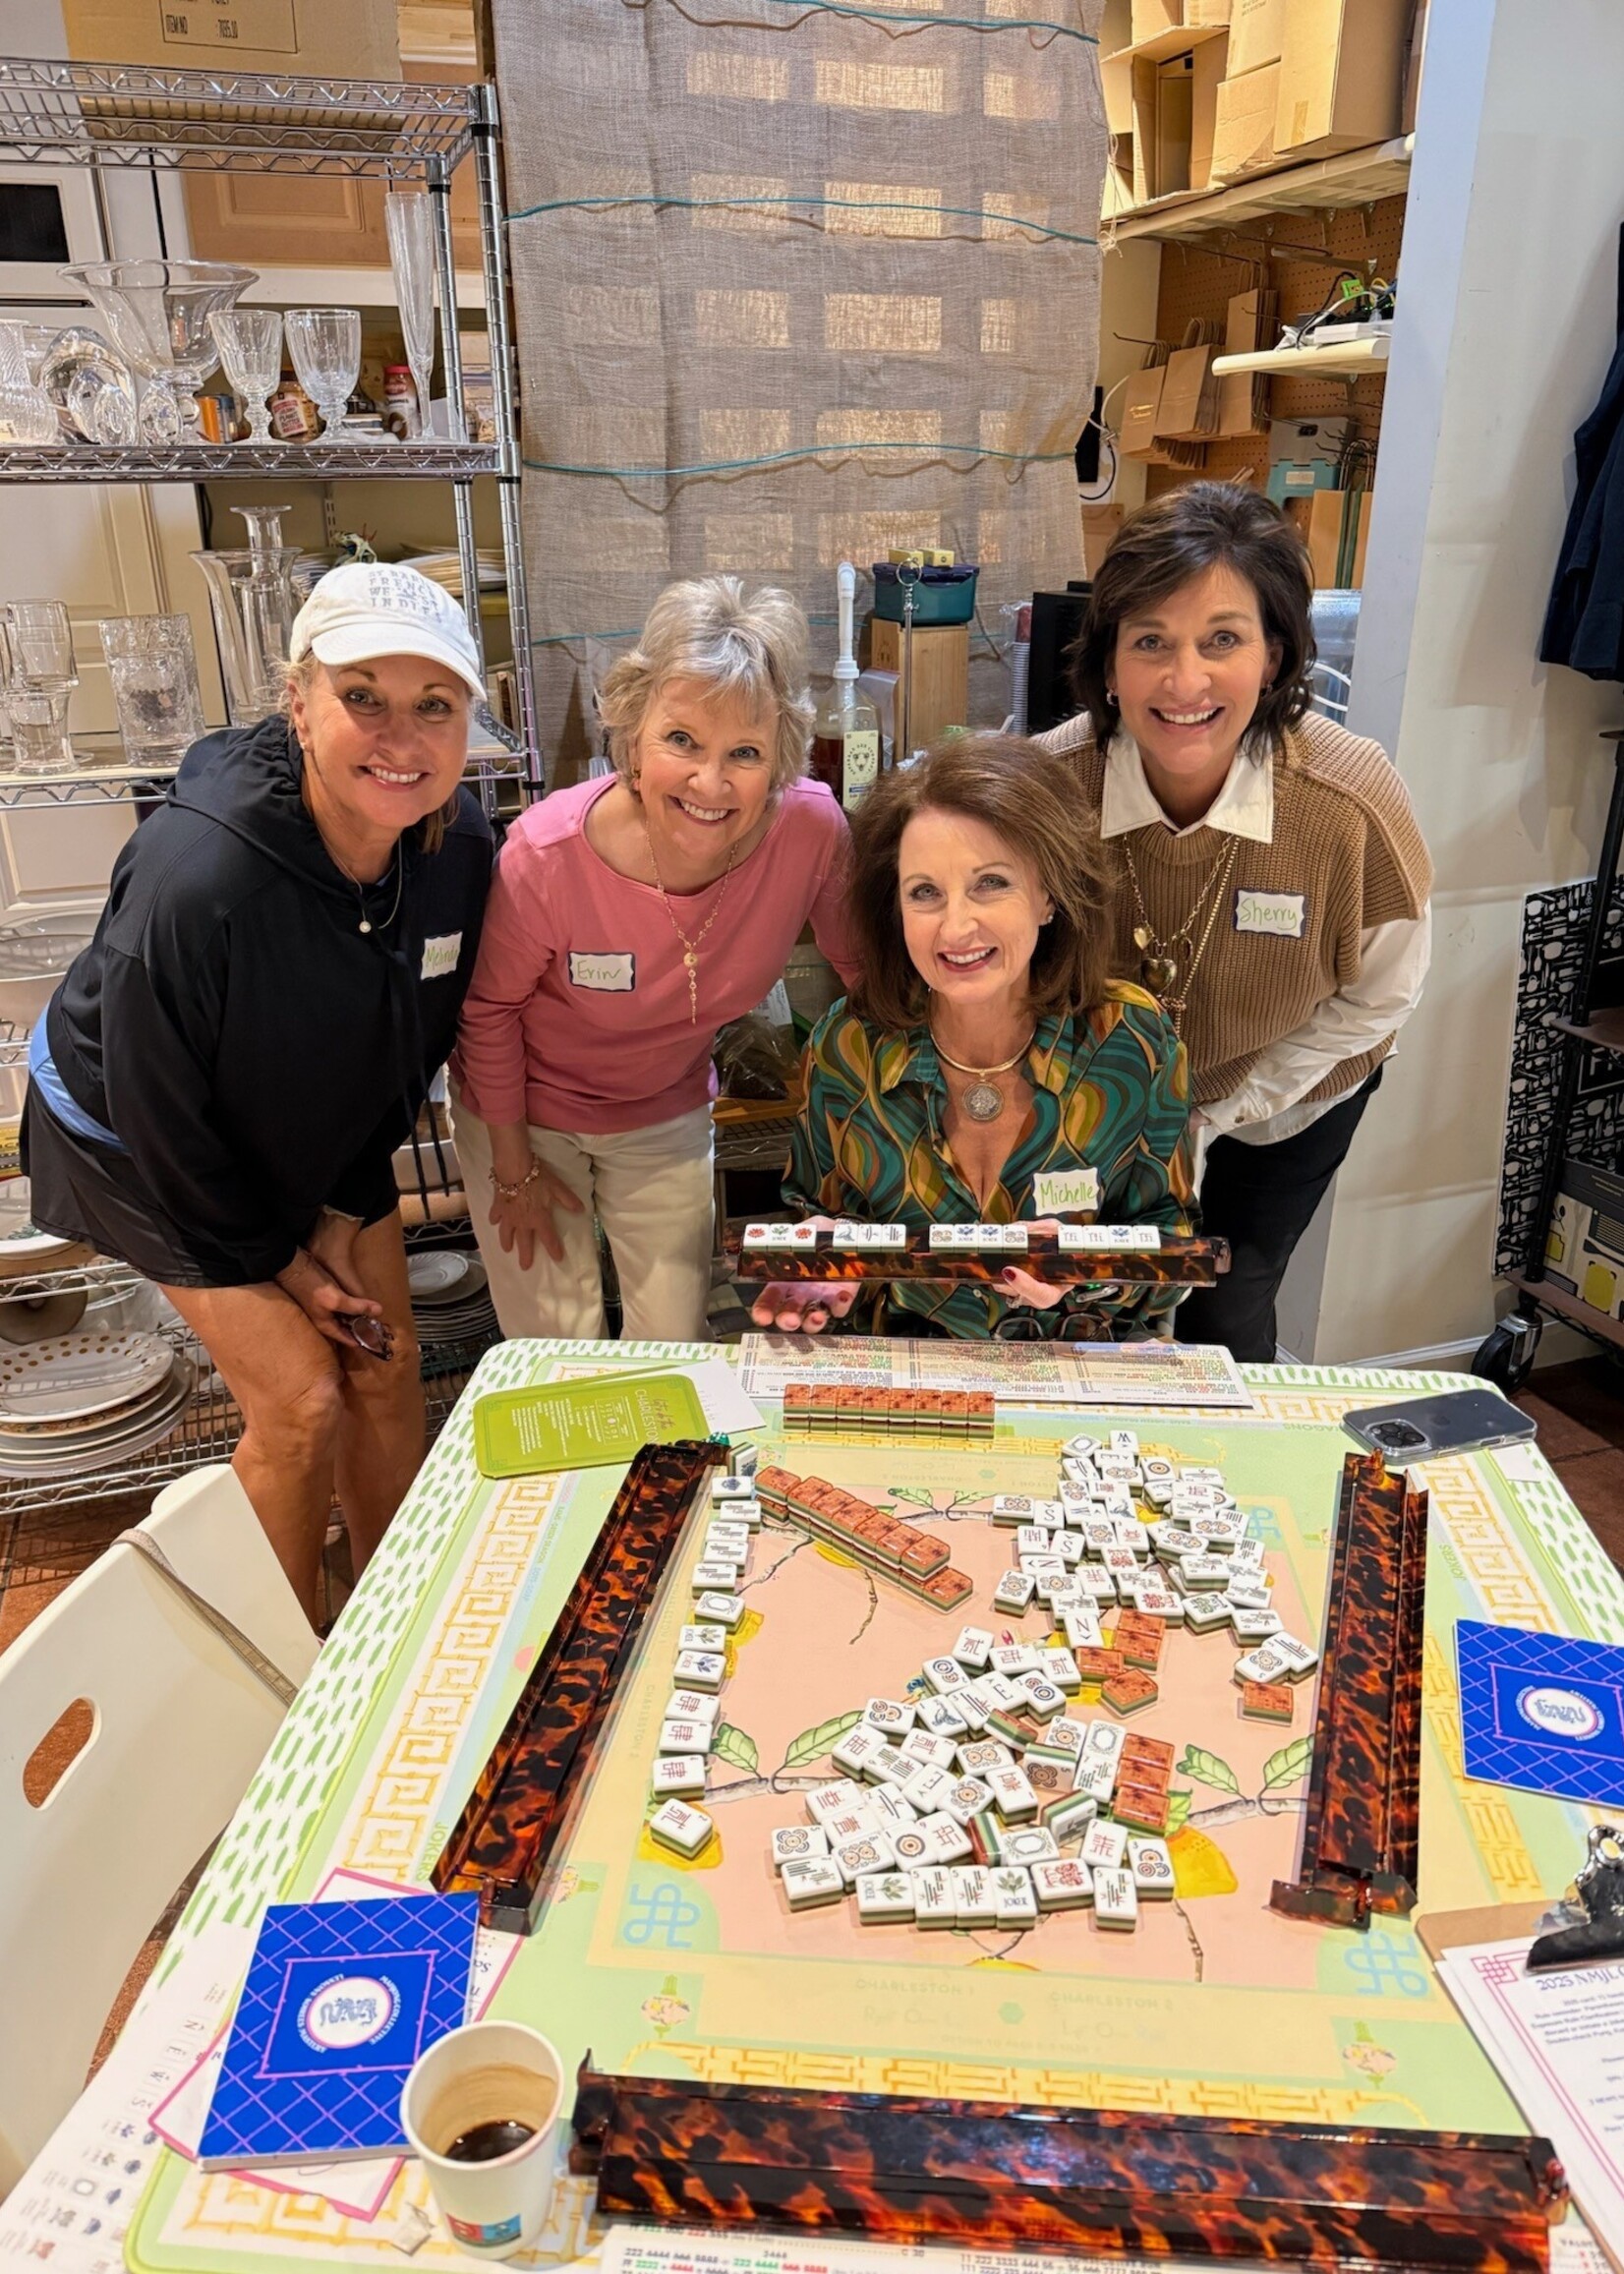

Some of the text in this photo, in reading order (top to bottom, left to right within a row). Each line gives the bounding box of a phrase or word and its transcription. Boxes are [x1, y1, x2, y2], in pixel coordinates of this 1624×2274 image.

[1240, 897, 1298, 931] Sherry
[1039, 1179, 1096, 1208] Michelle
[634, 1389, 661, 1444] CHARLESTON
[1044, 1509, 1056, 1521] S
[1061, 1541, 1073, 1553] S
[1038, 1559, 1060, 1568] N
[1438, 1545, 1468, 1581] JOKERS
[1075, 1618, 1090, 1632] N
[993, 1684, 1014, 1701] E
[633, 1684, 655, 1749] CHARLESTON
[415, 1821, 449, 1882] JOKERS
[1131, 1840, 1139, 1850] 3
[863, 1879, 876, 1901] JOKER
[1004, 1896, 1027, 1907] JOKER
[855, 1978, 961, 1996] CHARLESTON
[1536, 1969, 1619, 1992] 2025 NMJL
[1050, 1990, 1159, 2010] CHARLESTON
[624, 2247, 644, 2257] 222
[646, 2250, 670, 2259] 4444
[763, 2250, 788, 2259] 2468
[974, 2254, 993, 2265] 222
